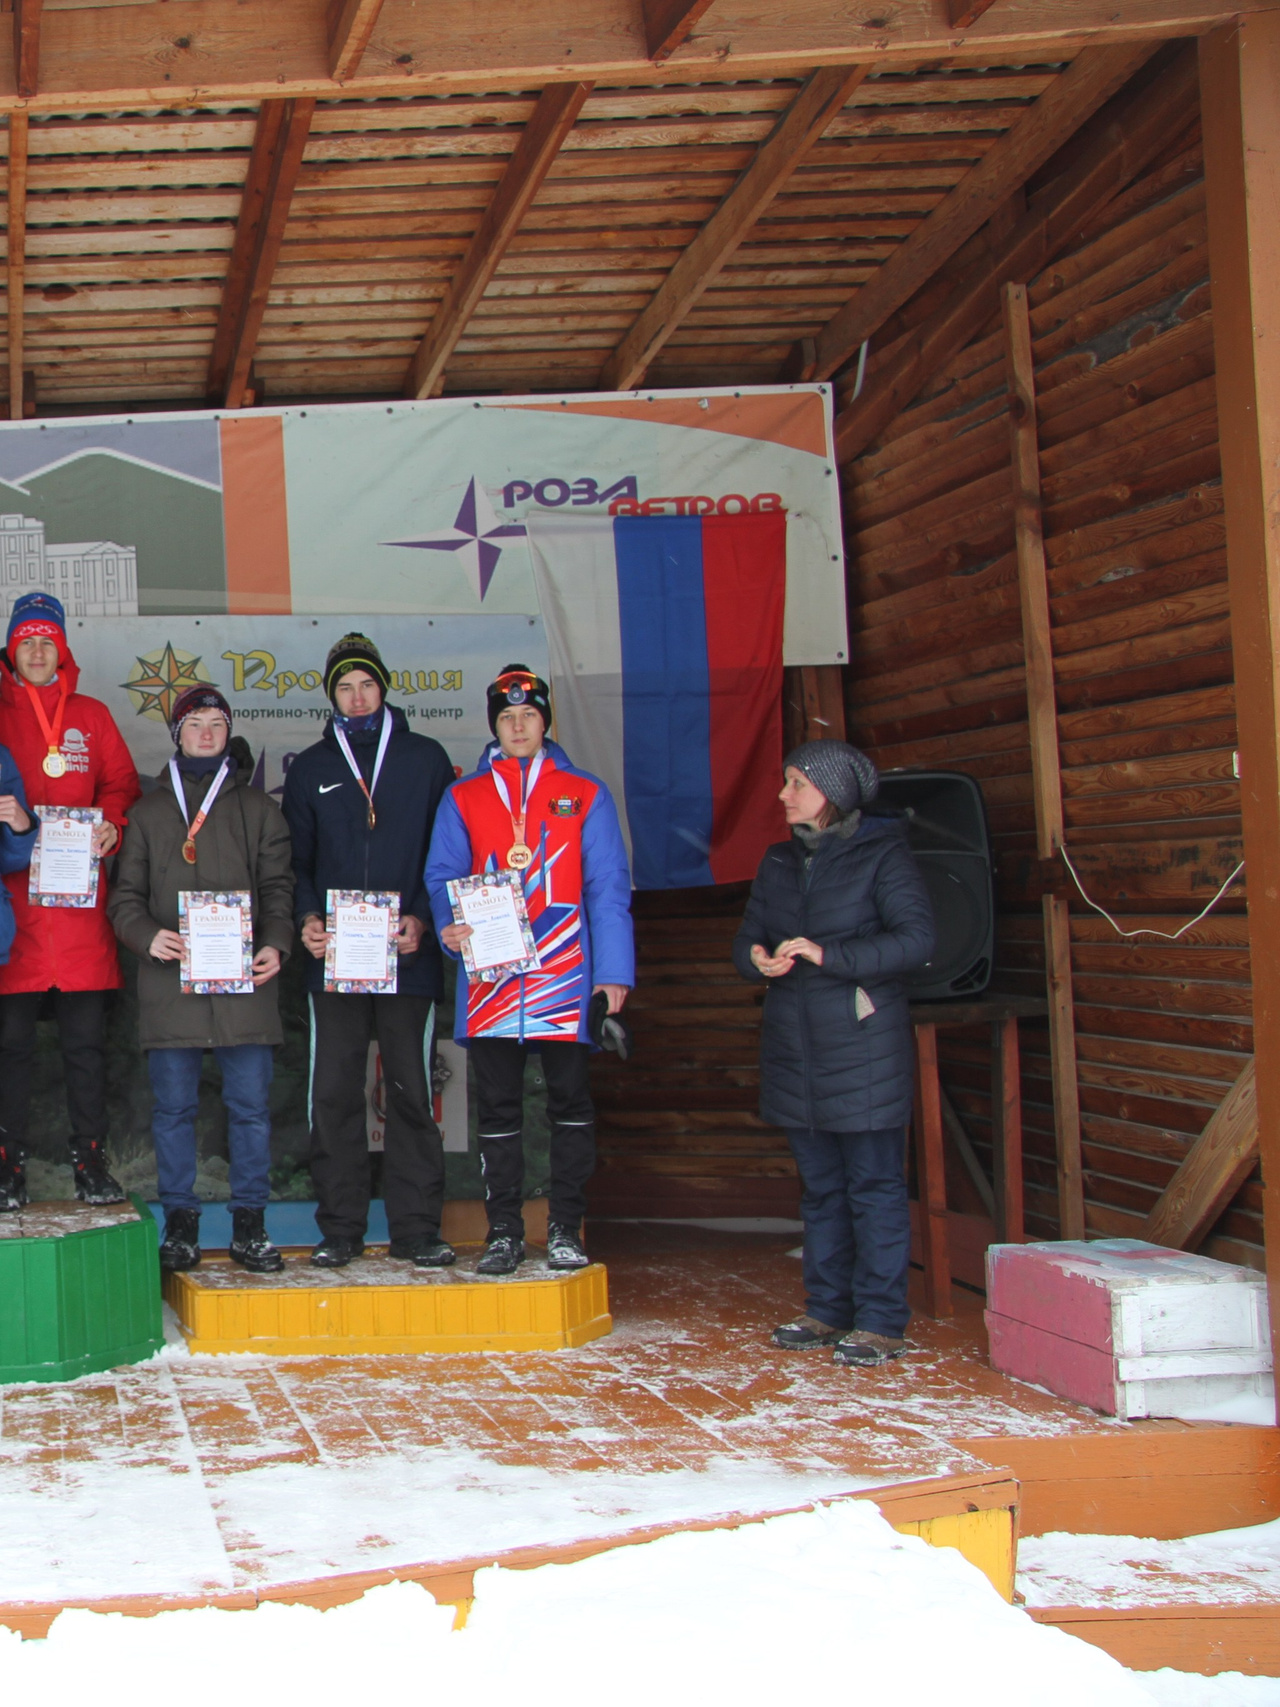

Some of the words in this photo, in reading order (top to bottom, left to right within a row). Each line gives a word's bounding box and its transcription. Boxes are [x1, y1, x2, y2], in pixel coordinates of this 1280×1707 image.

[504, 475, 637, 508] РОЗА
[221, 649, 462, 698] Проция
[421, 707, 463, 720] центр
[47, 829, 86, 838] ГРАМОТА
[468, 894, 508, 909] ГРАМОТА
[195, 915, 235, 923] ГРАМОТА
[342, 915, 383, 923] ГРАМОТА
